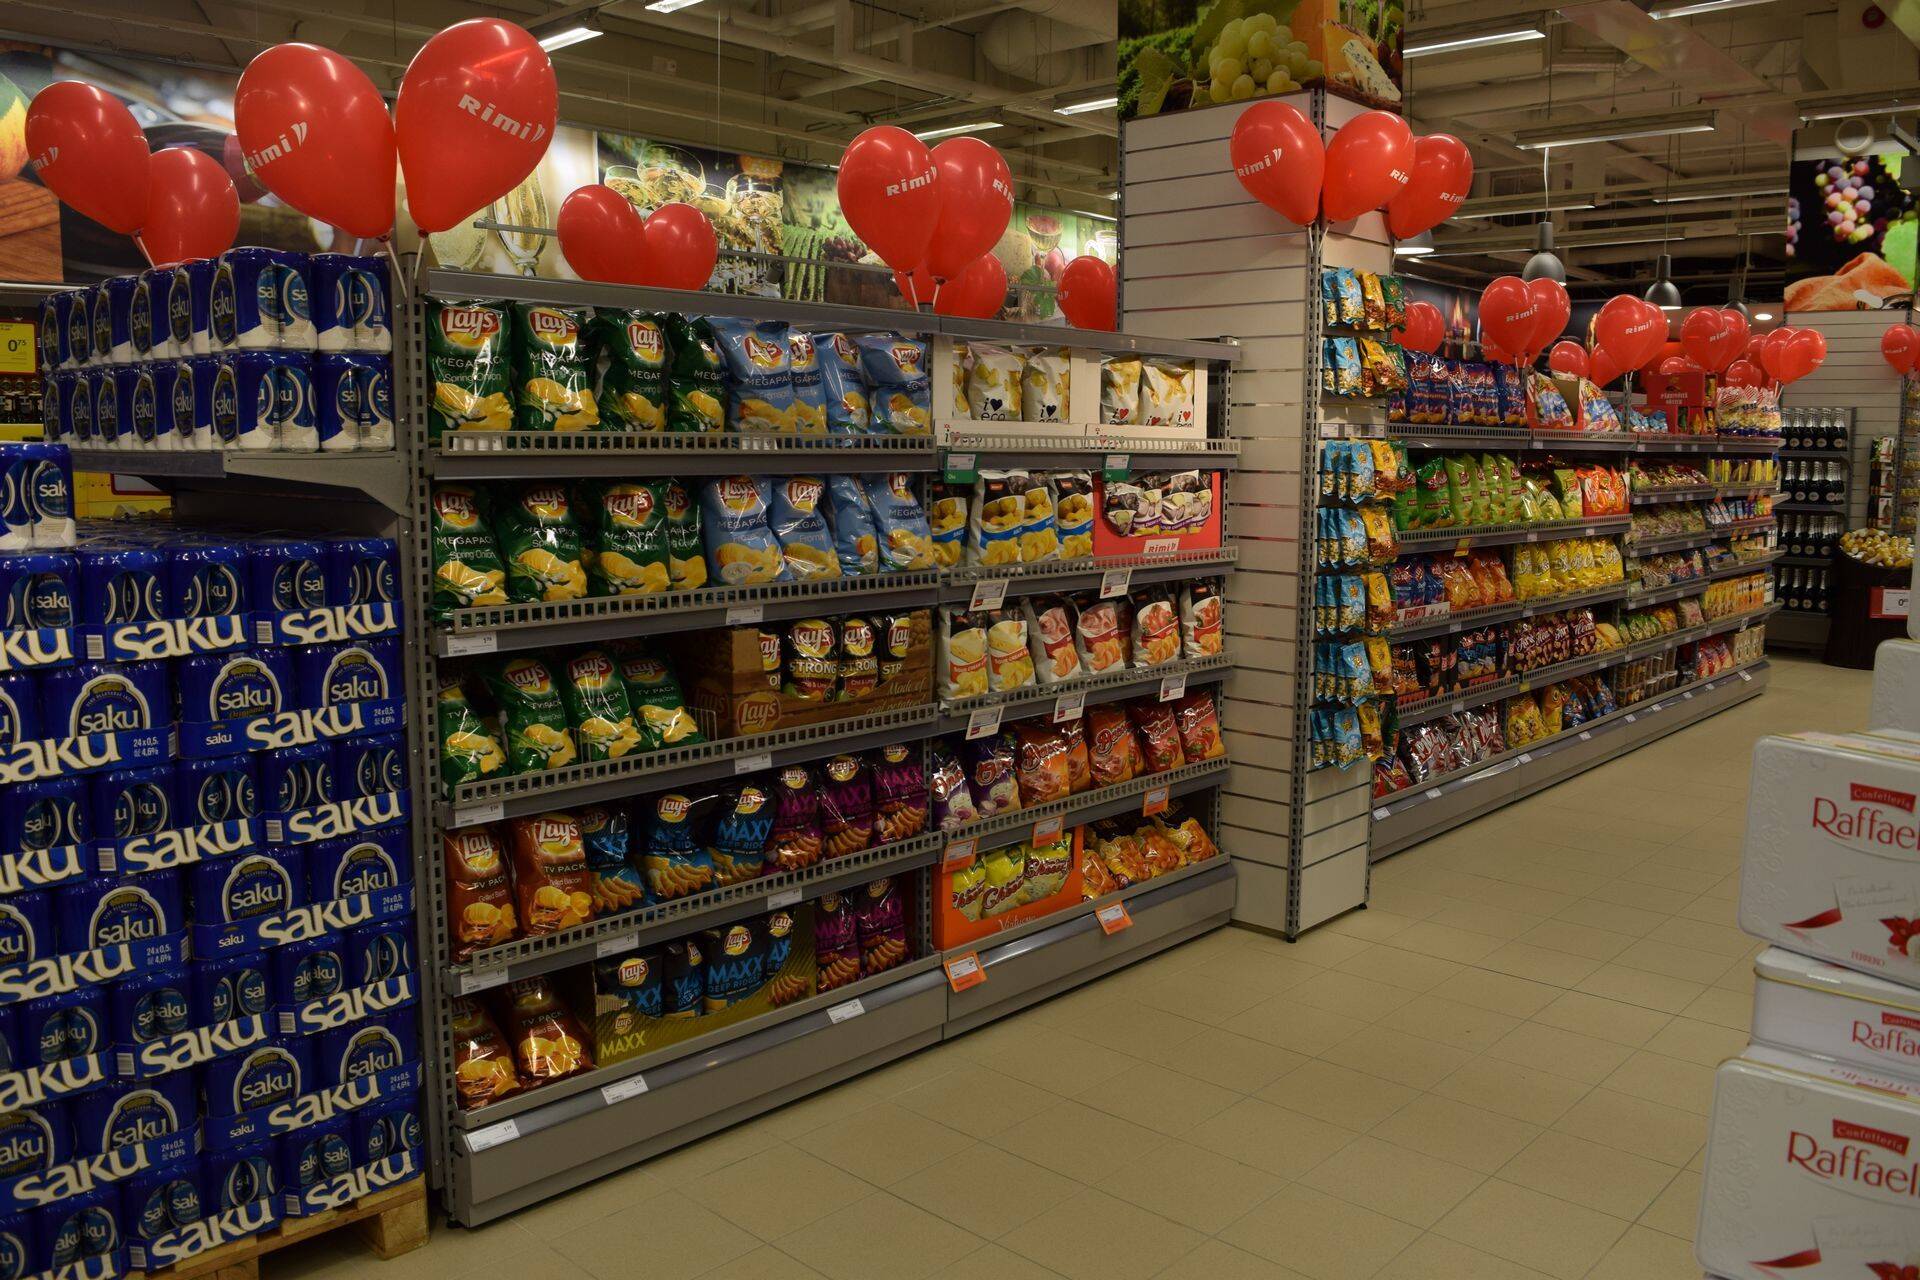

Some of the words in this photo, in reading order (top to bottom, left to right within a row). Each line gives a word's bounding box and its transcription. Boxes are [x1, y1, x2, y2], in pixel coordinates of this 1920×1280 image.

[458, 93, 532, 140] Rimi
[1235, 154, 1272, 177] Rimi
[886, 171, 930, 197] Rimi
[213, 291, 235, 316] saku
[291, 287, 309, 301] sa
[215, 392, 235, 416] saku
[39, 478, 68, 498] sak
[450, 549, 475, 561] Spring
[113, 613, 248, 662] saku
[280, 601, 397, 647] saku
[795, 628, 833, 650] Lay's
[890, 626, 909, 650] Lay
[0, 627, 75, 672] ku
[789, 659, 837, 674] STRONG
[219, 685, 272, 711] saku
[330, 674, 379, 703] saku
[80, 703, 140, 736] saku
[246, 702, 365, 752] saku
[205, 732, 233, 746] saku
[289, 791, 403, 845] saku
[538, 819, 580, 846] Lay's
[1813, 796, 1920, 851] Raffael
[123, 817, 255, 875] saku
[0, 844, 84, 894] ku
[341, 868, 388, 898] saku
[487, 876, 505, 888] PAC
[543, 865, 555, 874] TV
[556, 862, 587, 873] PACK
[230, 881, 283, 910] saku
[97, 915, 155, 947] saku
[258, 893, 374, 950] saku
[218, 934, 245, 949] saku
[621, 962, 647, 981] Lay's
[708, 952, 765, 985] MAXX
[301, 974, 413, 1036] saku
[615, 1014, 634, 1030] Lay's
[141, 1013, 268, 1078] saku
[600, 1030, 648, 1060] MAXX
[349, 1052, 394, 1082] saku
[242, 1071, 293, 1102] saku
[268, 1074, 381, 1137] saku
[112, 1116, 167, 1150] saku
[229, 1124, 255, 1139] saku
[1835, 1124, 1904, 1151] Confetteria
[13, 1142, 151, 1213] saku
[1787, 1130, 1920, 1198] Raffael
[305, 1150, 416, 1217] saku
[152, 1197, 275, 1270] saku
